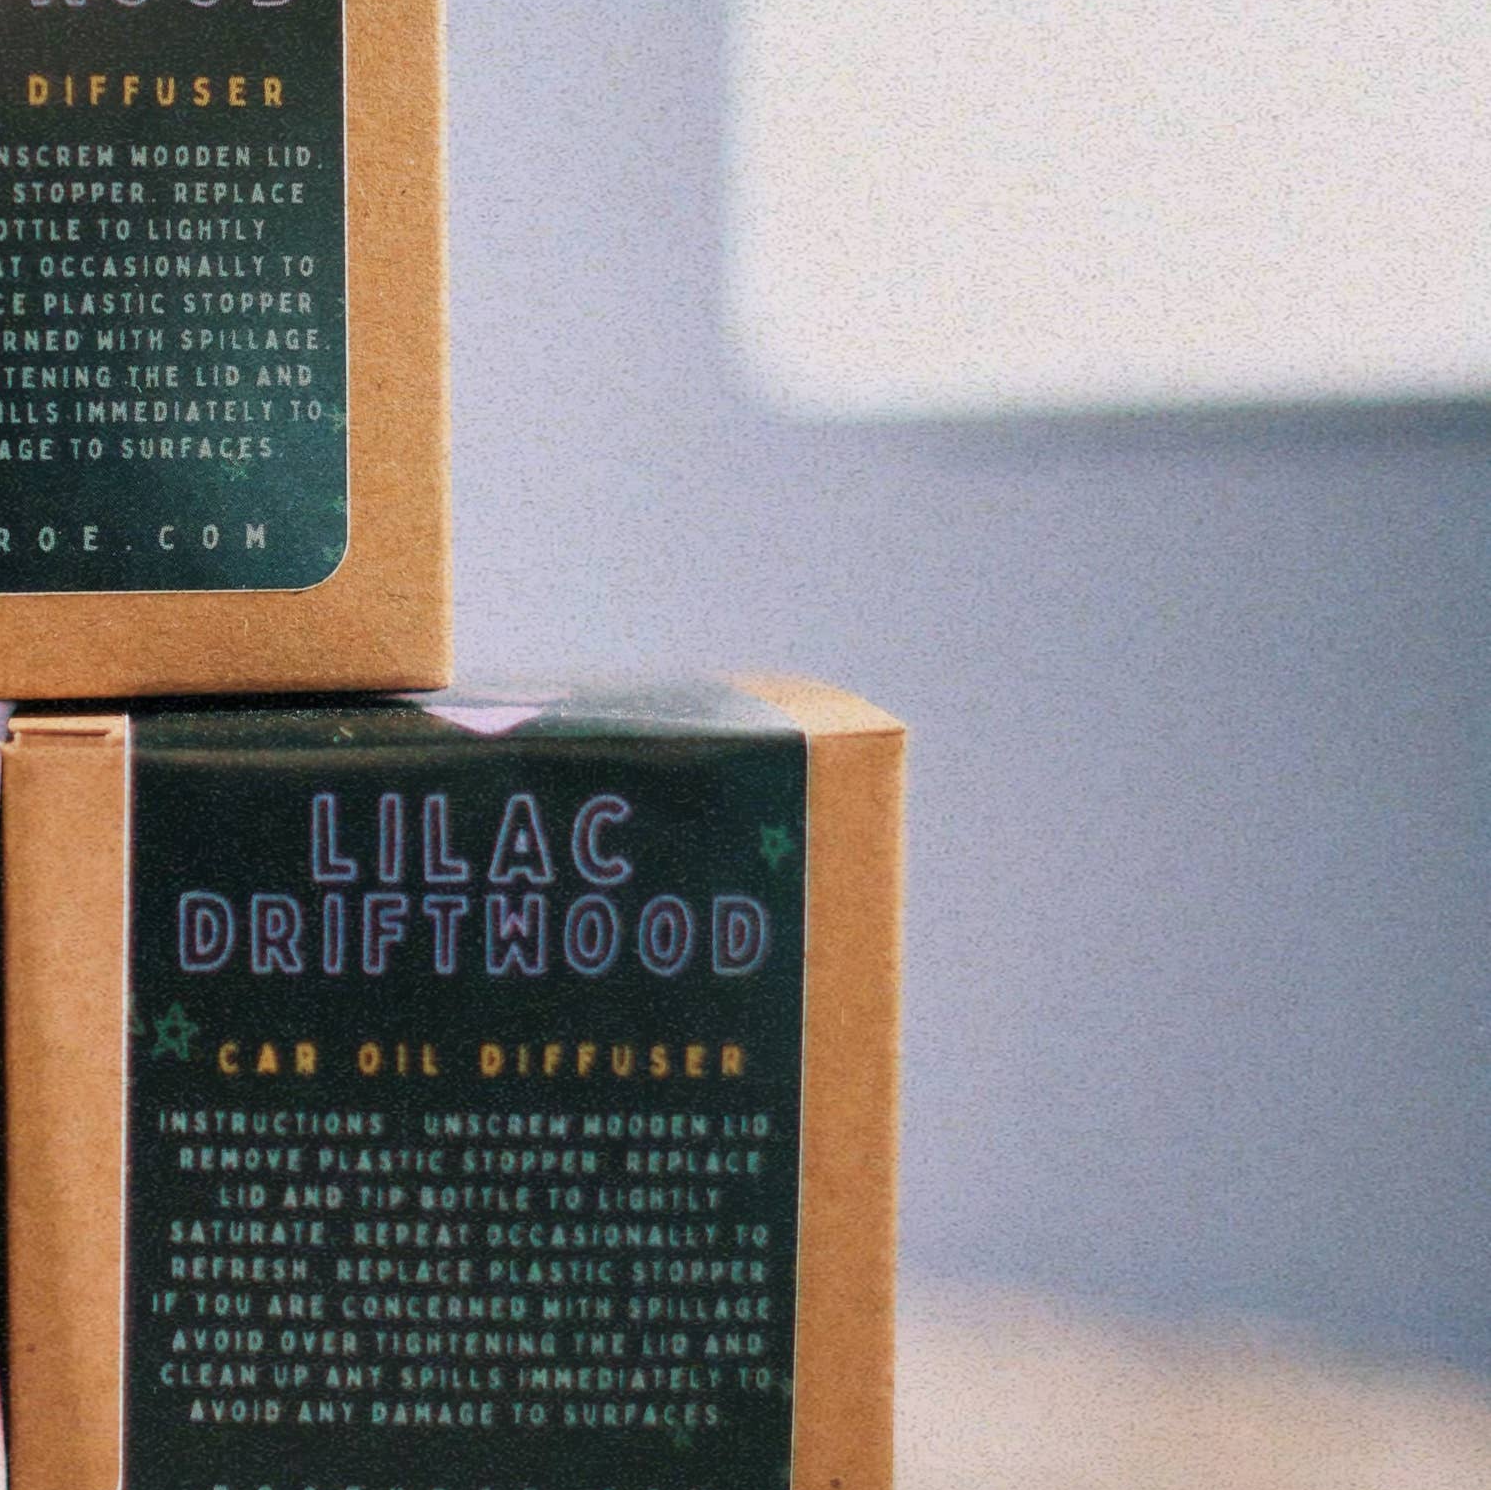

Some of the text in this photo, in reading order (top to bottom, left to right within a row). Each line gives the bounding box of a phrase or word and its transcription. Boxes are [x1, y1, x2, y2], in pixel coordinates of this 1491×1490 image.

[27, 73, 283, 107] DIFFUSER
[130, 144, 251, 168] WOODEN
[265, 143, 324, 169] LID.
[12, 181, 157, 205] STOPPER.
[173, 181, 304, 205] REPLACE
[97, 217, 132, 242] TO
[147, 217, 265, 242] LIGHTLY
[38, 254, 265, 279] OCCASIONALLY
[280, 254, 315, 278] TO
[42, 291, 165, 316] PLASTIC
[182, 291, 311, 315] STOPPER
[96, 328, 164, 351] WITH
[179, 327, 332, 352] SPILLAGE.
[128, 364, 179, 388] THE
[195, 363, 242, 388] LID
[256, 364, 313, 387] AND
[75, 399, 273, 424] IMMEDIATELY
[288, 398, 323, 424] TO
[70, 437, 105, 461] TO
[120, 435, 284, 462] SURFACES.
[310, 790, 634, 887] LILAC
[177, 889, 769, 978] DRIFTWOOD
[218, 1041, 743, 1077] CAR OIL DIFFUSER
[159, 1110, 384, 1136] INSTRUCTIONS
[423, 1113, 569, 1137] UNSCREW
[583, 1114, 709, 1138] WOODEN
[178, 1146, 301, 1171] REMOVE
[318, 1147, 443, 1174] PLASTIC
[626, 1150, 761, 1175] REPLACE
[218, 1183, 721, 1212] LID AND TIP BOTTLE TO LIGHTLY
[353, 1221, 469, 1247] REPEAT
[486, 1223, 718, 1249] OCCASIONALLY
[734, 1223, 769, 1248] TO
[336, 1257, 472, 1284] REPLACE
[488, 1259, 613, 1285] PLASTIC
[632, 1259, 765, 1285] STOPPER
[152, 1290, 179, 1315] IF
[195, 1292, 251, 1317] YOU
[267, 1294, 324, 1319] ARE
[341, 1295, 528, 1321] CONCERNED
[542, 1297, 612, 1320] WITH
[171, 1328, 763, 1357] AVOID OVER TIGHTENING THE LID AND
[159, 1362, 772, 1392] CLEAN UP ANY SPILLS IMMEDIATELY TO
[189, 1399, 282, 1424] AVOID
[297, 1401, 353, 1424] ANY
[370, 1401, 493, 1427] DAMAGE
[512, 1402, 547, 1427] TO
